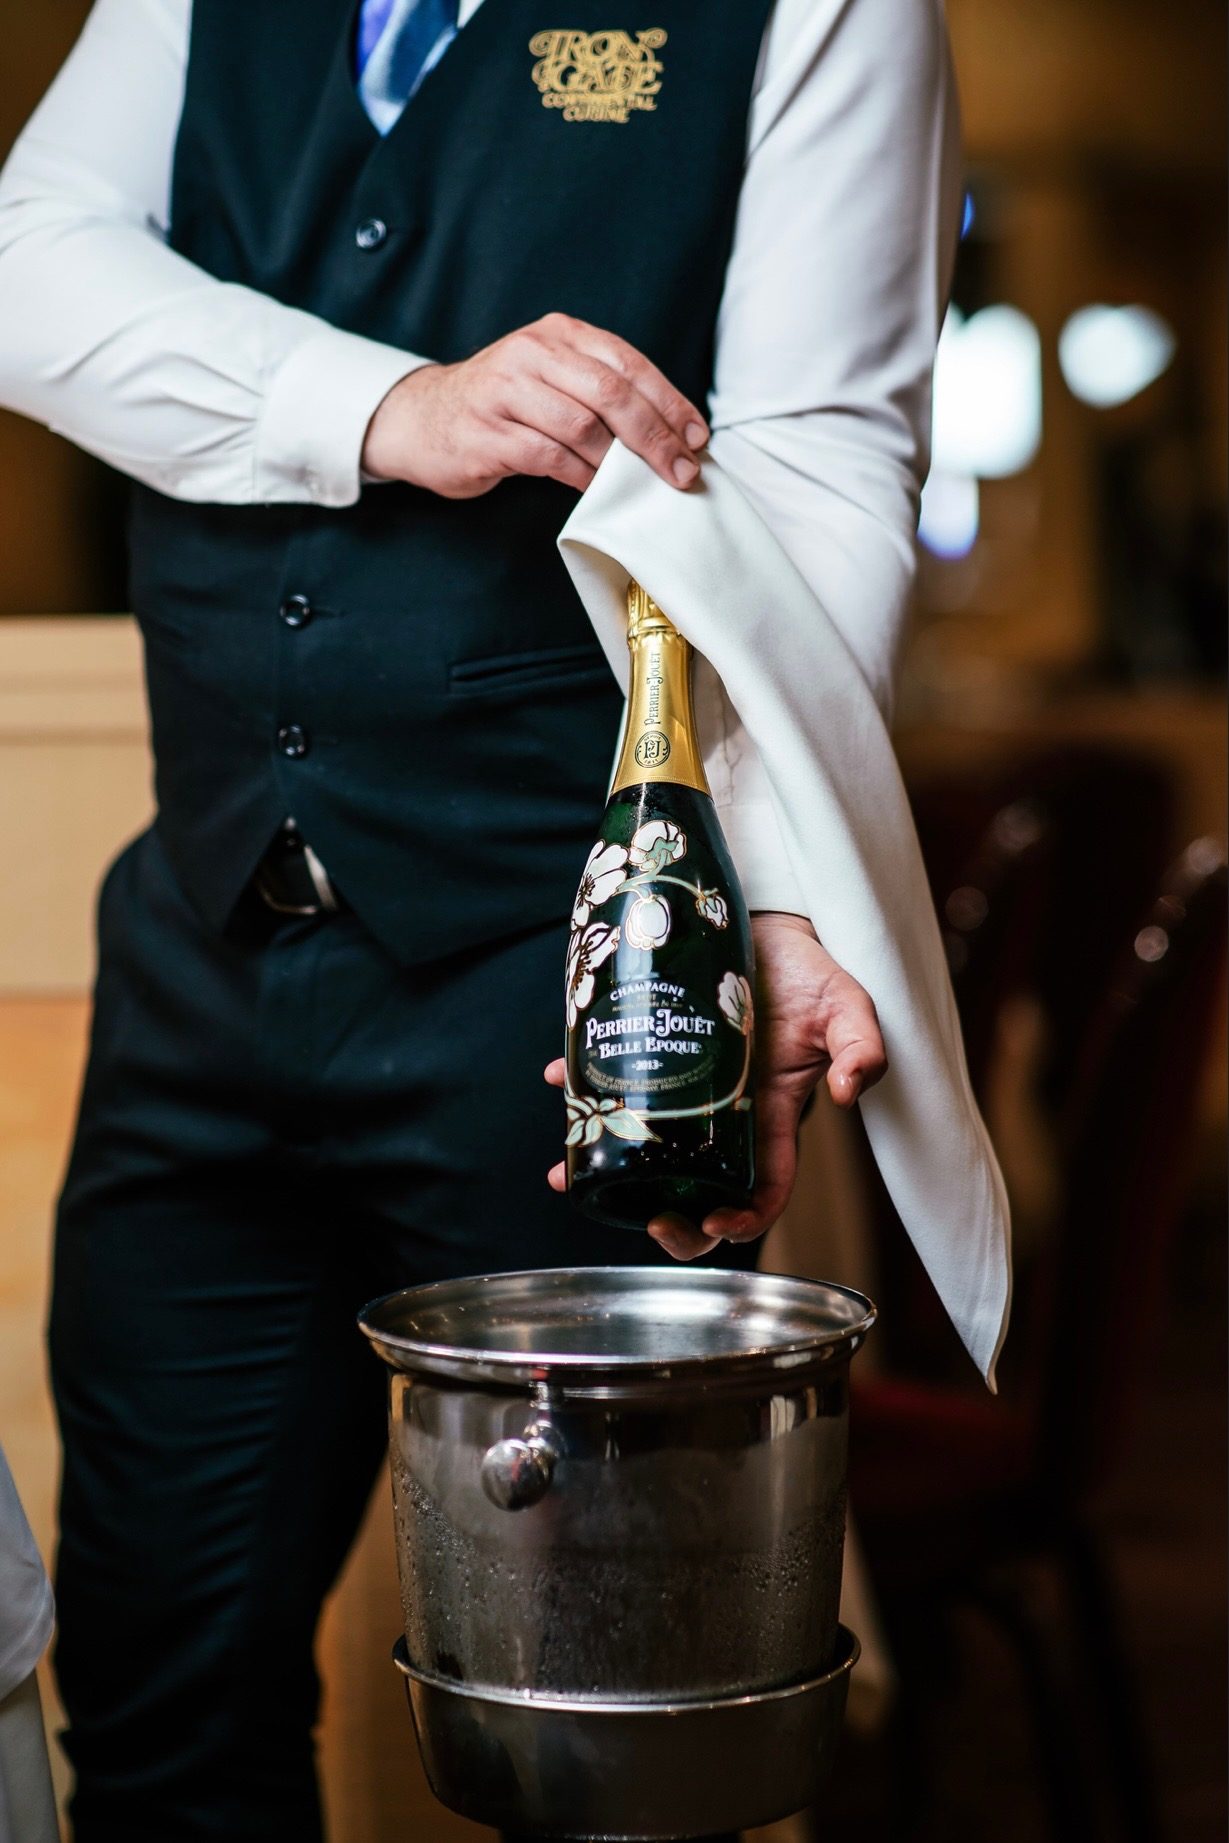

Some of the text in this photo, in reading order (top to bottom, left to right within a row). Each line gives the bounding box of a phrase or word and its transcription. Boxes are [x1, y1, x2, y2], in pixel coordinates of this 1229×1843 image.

[530, 27, 668, 63] IRON
[610, 981, 685, 1001] CHAMPAGNE
[599, 1036, 701, 1060] BELLE EPOQUE
